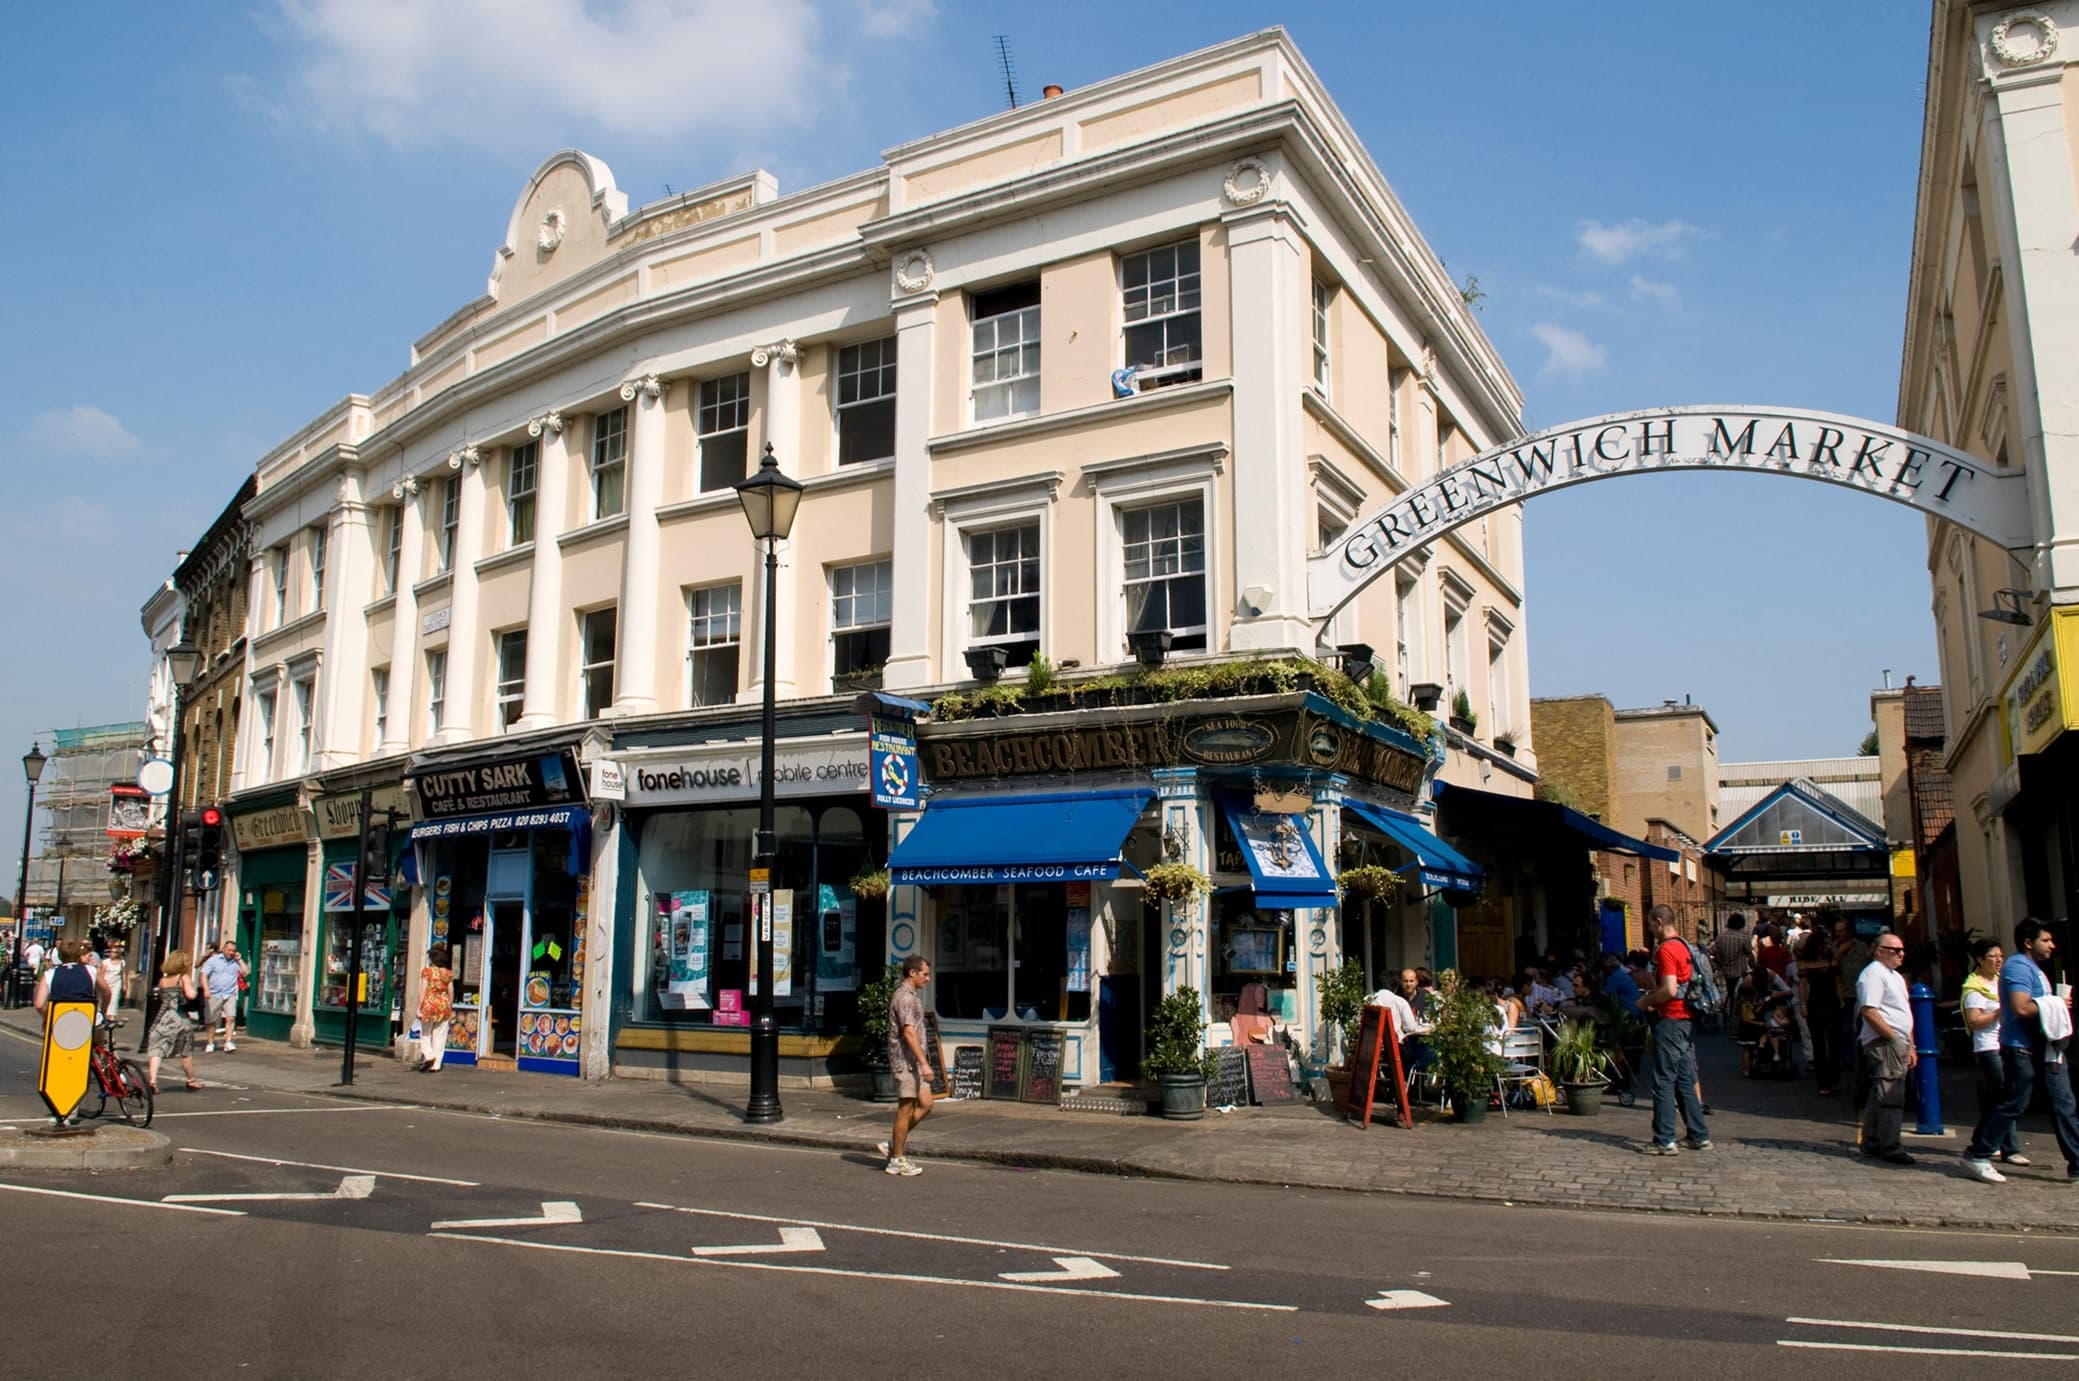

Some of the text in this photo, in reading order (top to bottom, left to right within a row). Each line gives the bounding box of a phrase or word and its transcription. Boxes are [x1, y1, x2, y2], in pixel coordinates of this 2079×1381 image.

[1344, 417, 1976, 569] GREENWICH MARKET
[1204, 721, 1223, 732] SEA
[932, 726, 1177, 778] BEACHCOMBER
[1202, 748, 1257, 761] RESTAURANT
[422, 763, 533, 798] CUTTY SARK
[601, 768, 619, 780] fone
[601, 778, 624, 790] house
[637, 766, 741, 792] fonehouse
[816, 759, 869, 780] centre
[457, 797, 466, 810] &
[467, 790, 531, 810] RESTAURANT
[410, 825, 443, 839] BURGERS
[443, 821, 460, 835] FISH
[459, 821, 467, 833] &
[467, 819, 489, 832] CHIPS
[489, 817, 513, 830] PIZZA
[901, 864, 1107, 881] BEACHCOMBER SEAFOOD CAFE
